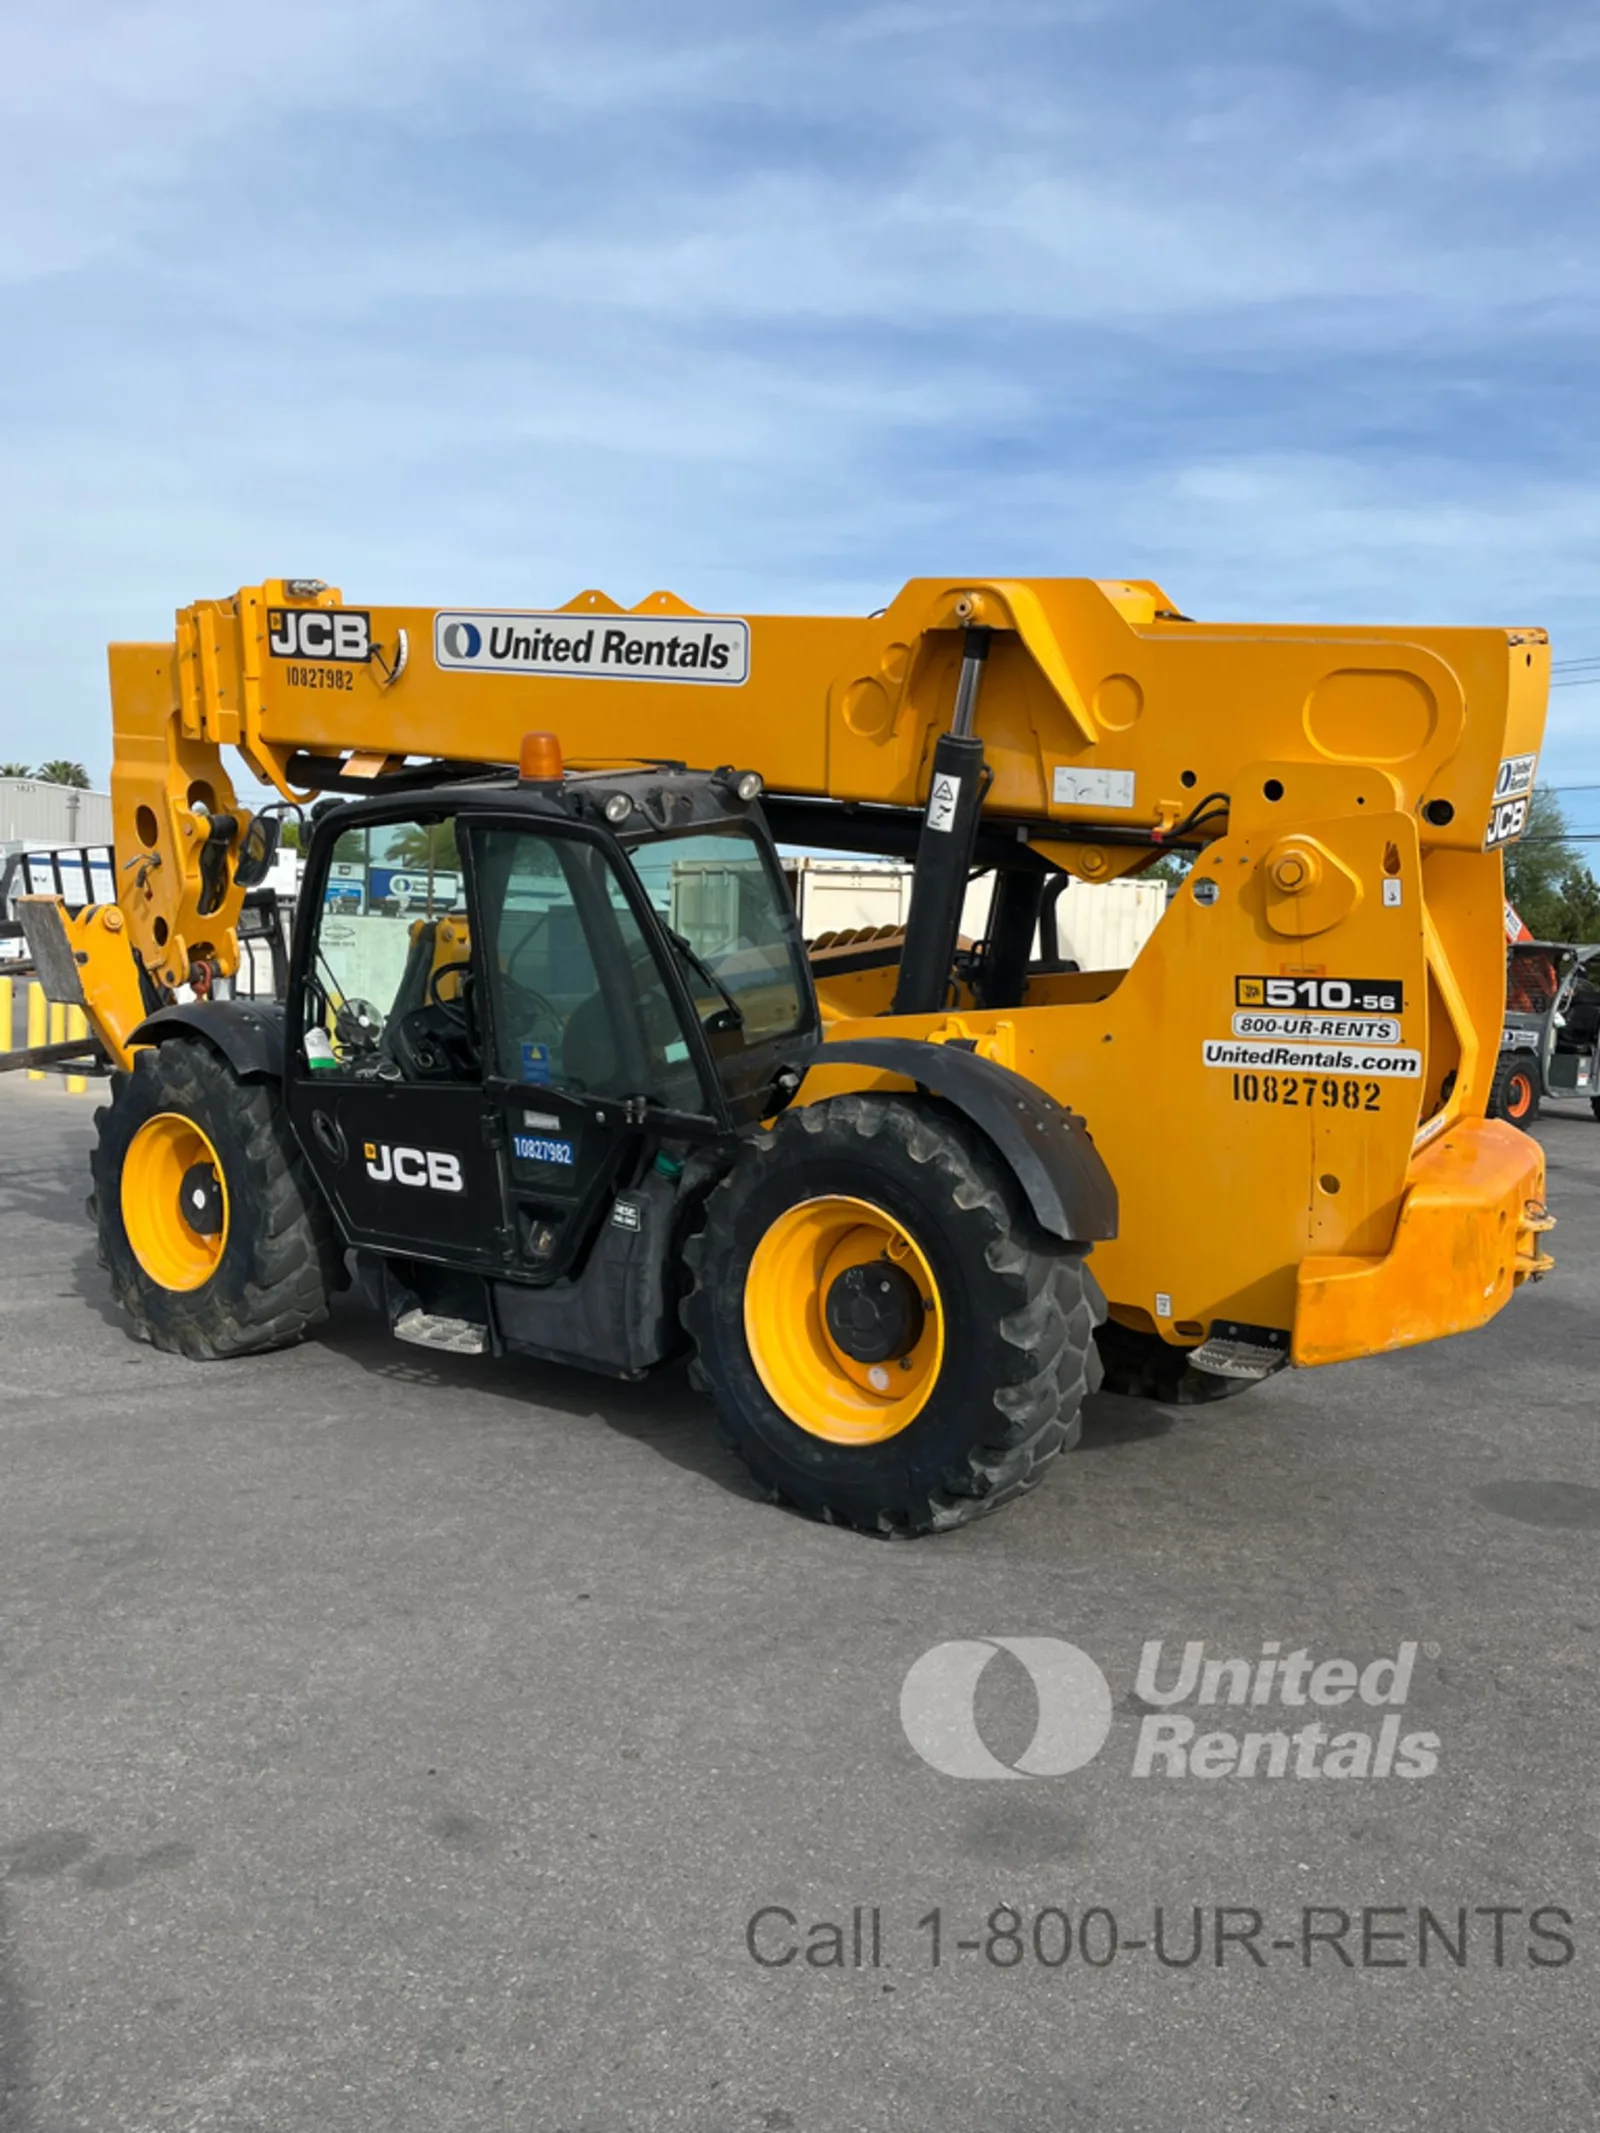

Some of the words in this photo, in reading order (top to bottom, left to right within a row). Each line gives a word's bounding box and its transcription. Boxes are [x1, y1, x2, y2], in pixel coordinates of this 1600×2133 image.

[271, 612, 369, 658] JCB
[489, 626, 595, 663] United
[601, 629, 731, 669] Rentals
[286, 666, 354, 691] 10827982
[1487, 800, 1526, 842] JCB
[1265, 978, 1396, 1011] 510-56
[1239, 1017, 1392, 1039] 800-UR-RENTS
[1205, 1045, 1418, 1072] UnitedRentals.com
[1232, 1073, 1381, 1112] 10827982
[513, 1136, 573, 1164] 10827982
[366, 1145, 464, 1192] JCB
